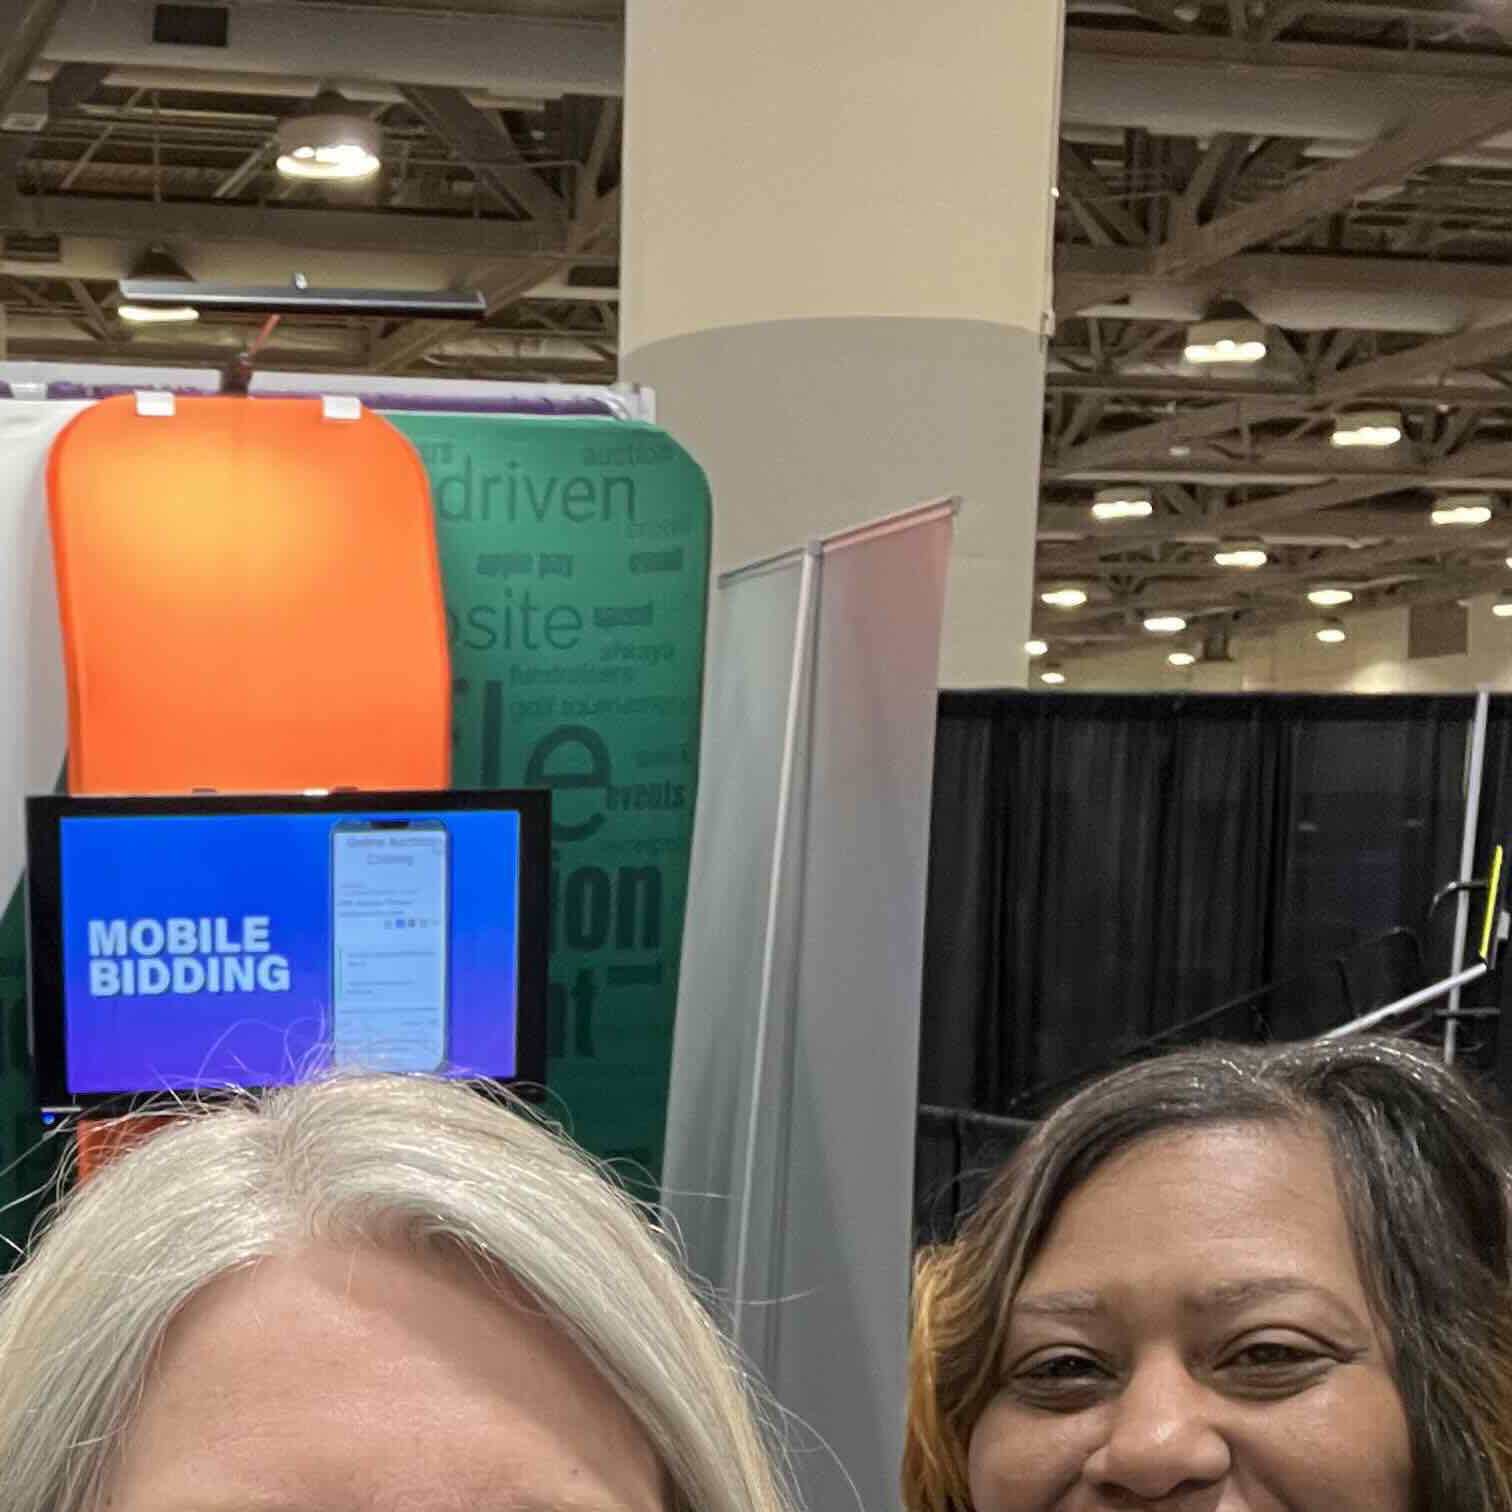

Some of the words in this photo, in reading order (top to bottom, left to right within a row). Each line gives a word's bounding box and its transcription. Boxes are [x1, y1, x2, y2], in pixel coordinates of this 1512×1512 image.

[439, 455, 635, 523] driven
[88, 915, 271, 957] MOBILE
[89, 956, 290, 998] BIDDING
